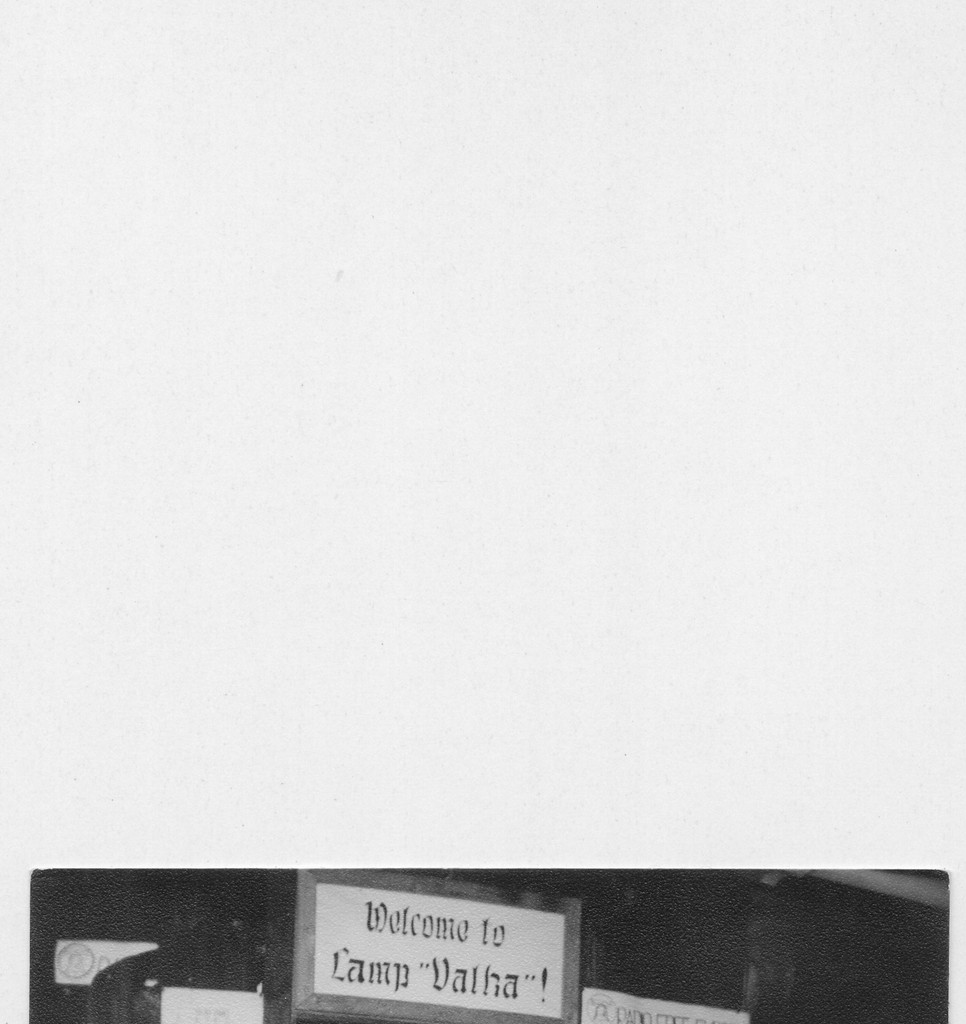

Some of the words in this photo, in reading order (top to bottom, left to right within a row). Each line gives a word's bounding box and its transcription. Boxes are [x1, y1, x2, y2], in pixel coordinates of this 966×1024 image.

[364, 900, 469, 943] Welcome
[482, 916, 506, 947] to
[330, 946, 410, 993] Camp
